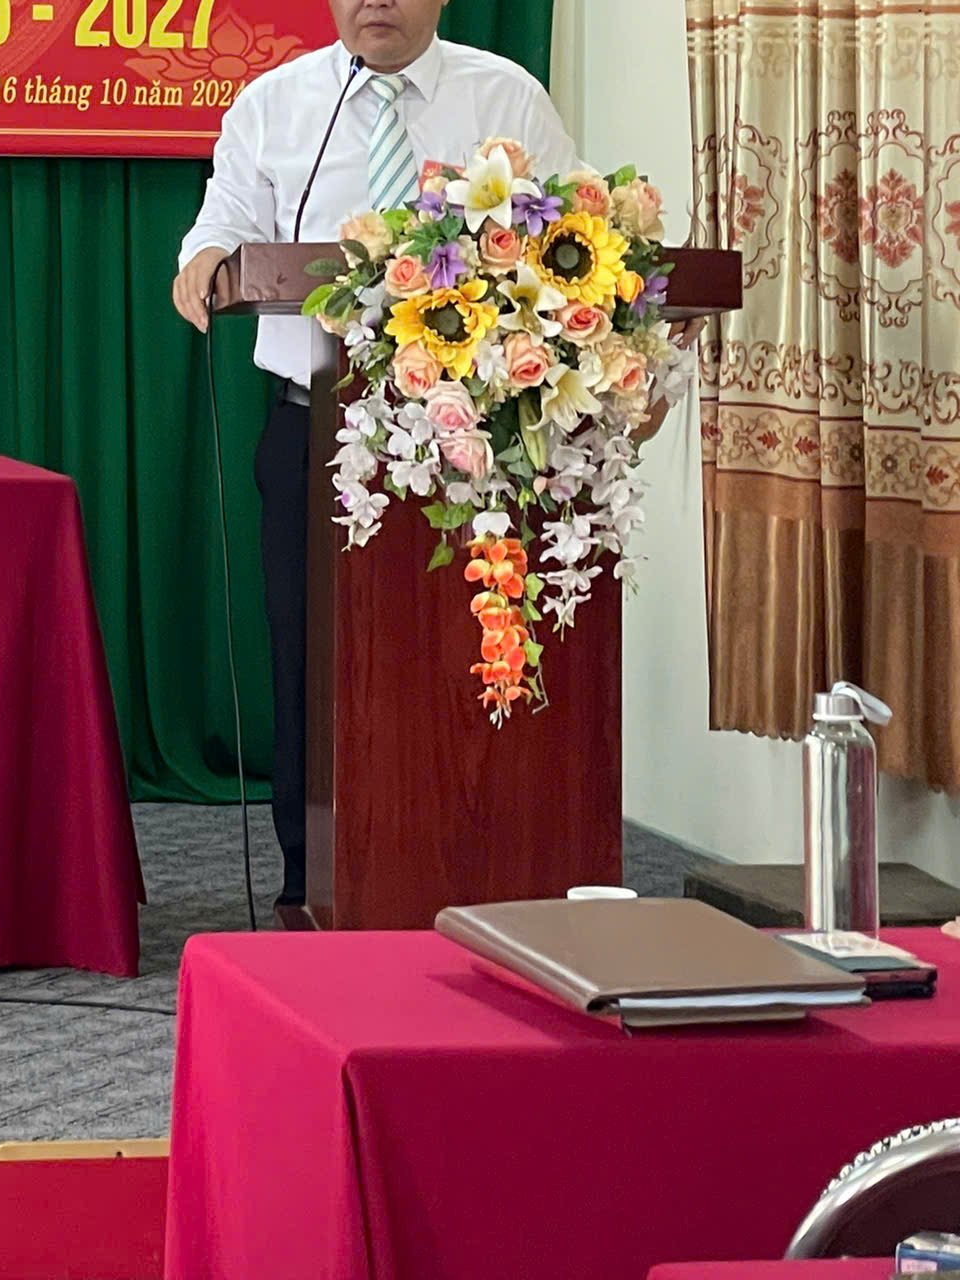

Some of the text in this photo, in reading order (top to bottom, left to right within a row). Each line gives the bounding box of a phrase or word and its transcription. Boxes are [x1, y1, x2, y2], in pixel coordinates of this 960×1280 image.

[32, 5, 53, 20] -
[25, 75, 92, 110] tháng
[101, 79, 126, 104] 10
[133, 80, 182, 105] năm
